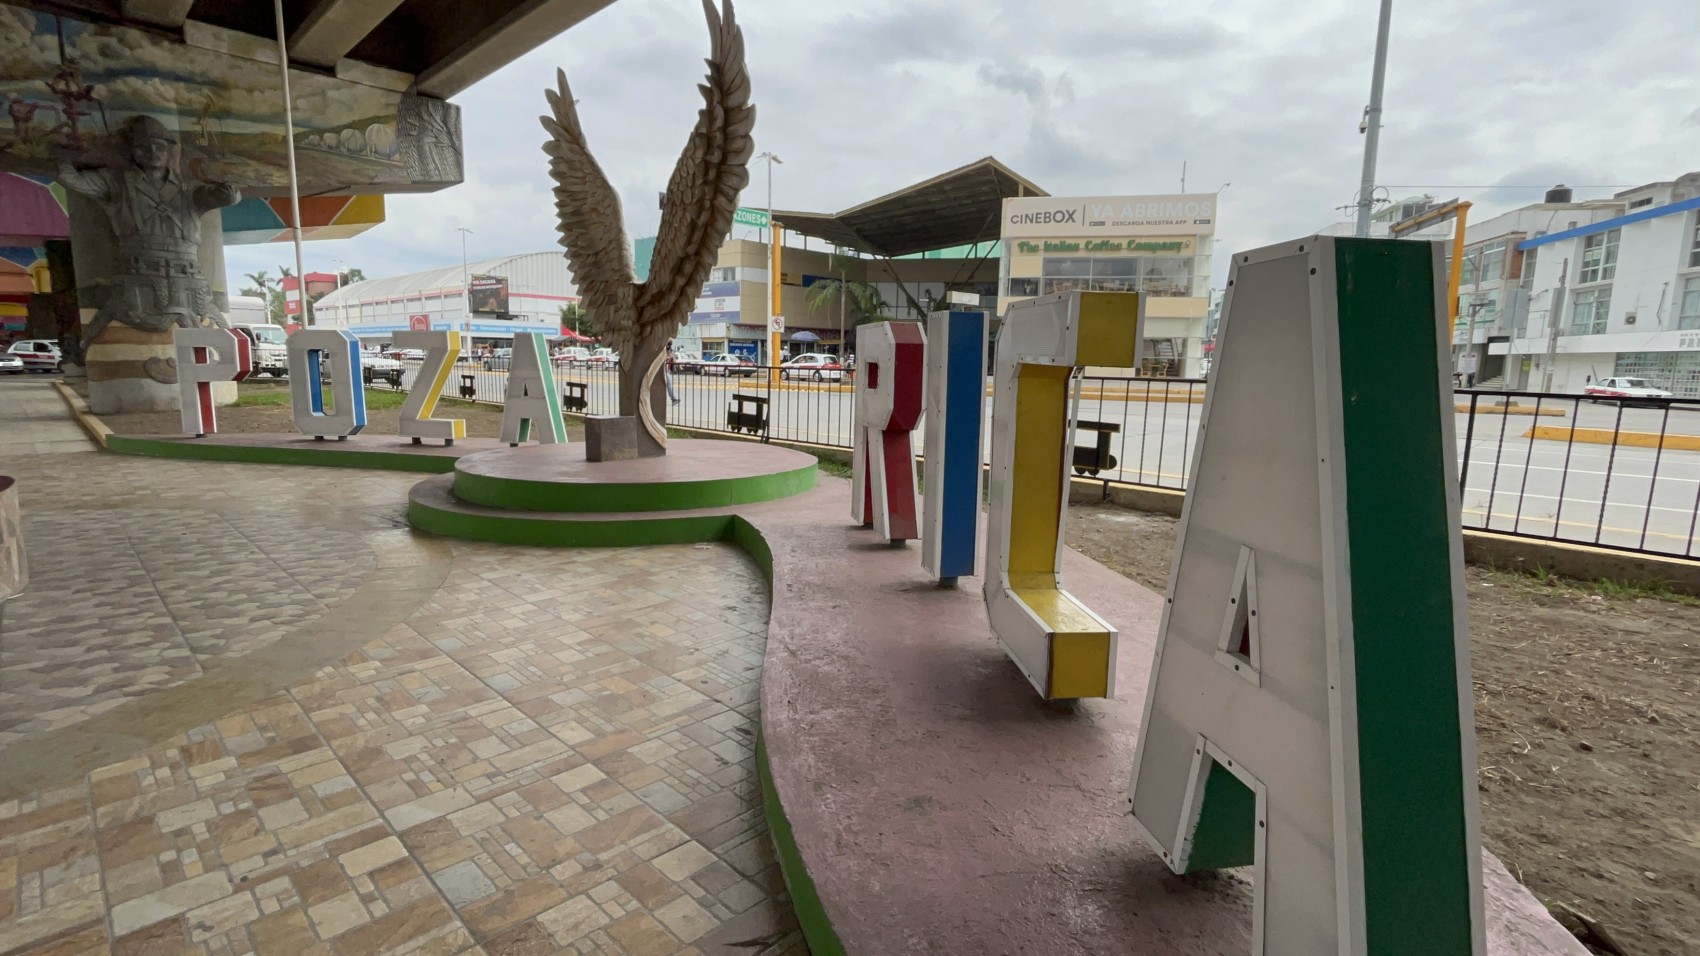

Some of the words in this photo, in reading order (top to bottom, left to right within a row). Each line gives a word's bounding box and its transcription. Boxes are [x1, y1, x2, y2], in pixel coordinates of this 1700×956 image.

[1010, 209, 1077, 224] CINEBOX
[1090, 204, 1115, 219] YA
[1119, 201, 1213, 217] ABRIMOS
[1017, 240, 1040, 252] The
[1044, 240, 1080, 252] Italian
[1085, 240, 1122, 252] Coffee
[1127, 240, 1183, 253] Company
[173, 326, 569, 446] POZA
[851, 236, 1480, 956] RICA
